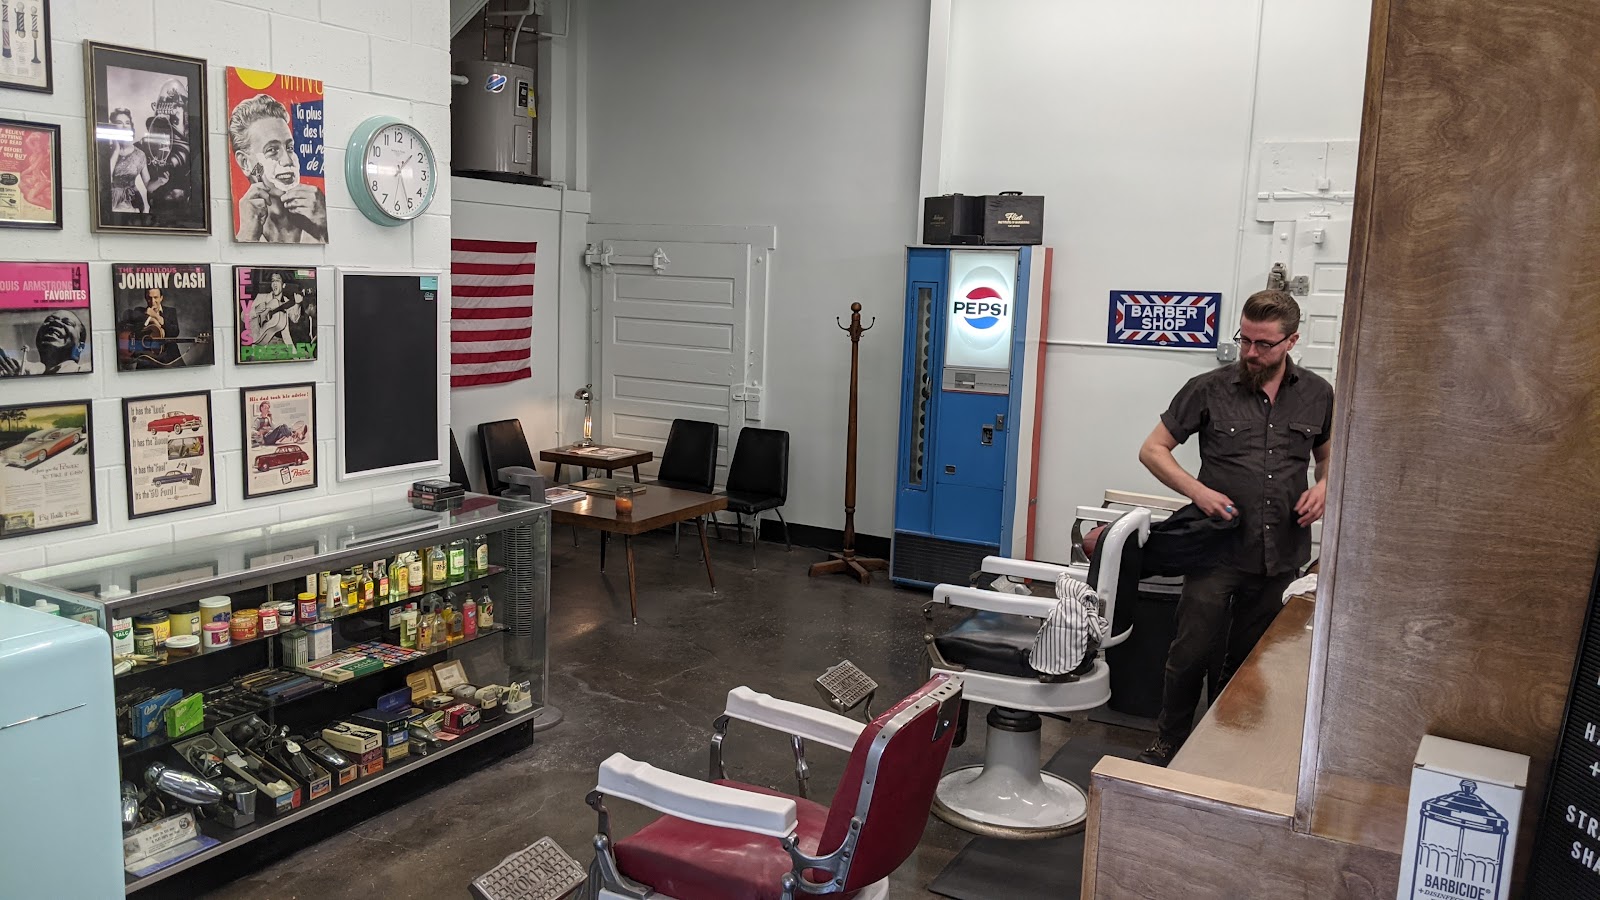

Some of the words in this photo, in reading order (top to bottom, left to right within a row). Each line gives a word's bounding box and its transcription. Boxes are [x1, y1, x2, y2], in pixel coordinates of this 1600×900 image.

[306, 105, 322, 122] plus
[303, 124, 318, 138] des
[394, 131, 403, 144] 12
[409, 138, 413, 149] 1
[300, 140, 312, 158] qui
[373, 145, 381, 157] 10
[417, 152, 424, 163] 2
[306, 157, 319, 171] de
[420, 170, 427, 181] 3
[371, 180, 378, 191] 8
[416, 187, 422, 197] 4
[382, 193, 389, 204] 7
[407, 198, 413, 210] 5
[394, 200, 401, 212] 6
[23, 280, 73, 291] ARMSTRONG
[118, 272, 170, 289] JOHNNY
[173, 272, 206, 289] CASH
[44, 290, 87, 300] FAVORITES
[239, 267, 254, 346] ELVIS
[953, 301, 1008, 316] PEPSI
[1130, 305, 1198, 319] BARBER
[1141, 317, 1187, 331] SHOP
[241, 343, 317, 360] PRESLEY
[135, 406, 144, 415] has
[144, 405, 152, 414] the
[137, 438, 145, 447] has
[145, 437, 153, 446] the
[138, 465, 146, 474] has
[146, 463, 154, 473] the
[115, 630, 129, 638] TALC
[1424, 873, 1486, 900] BARBICIDE
